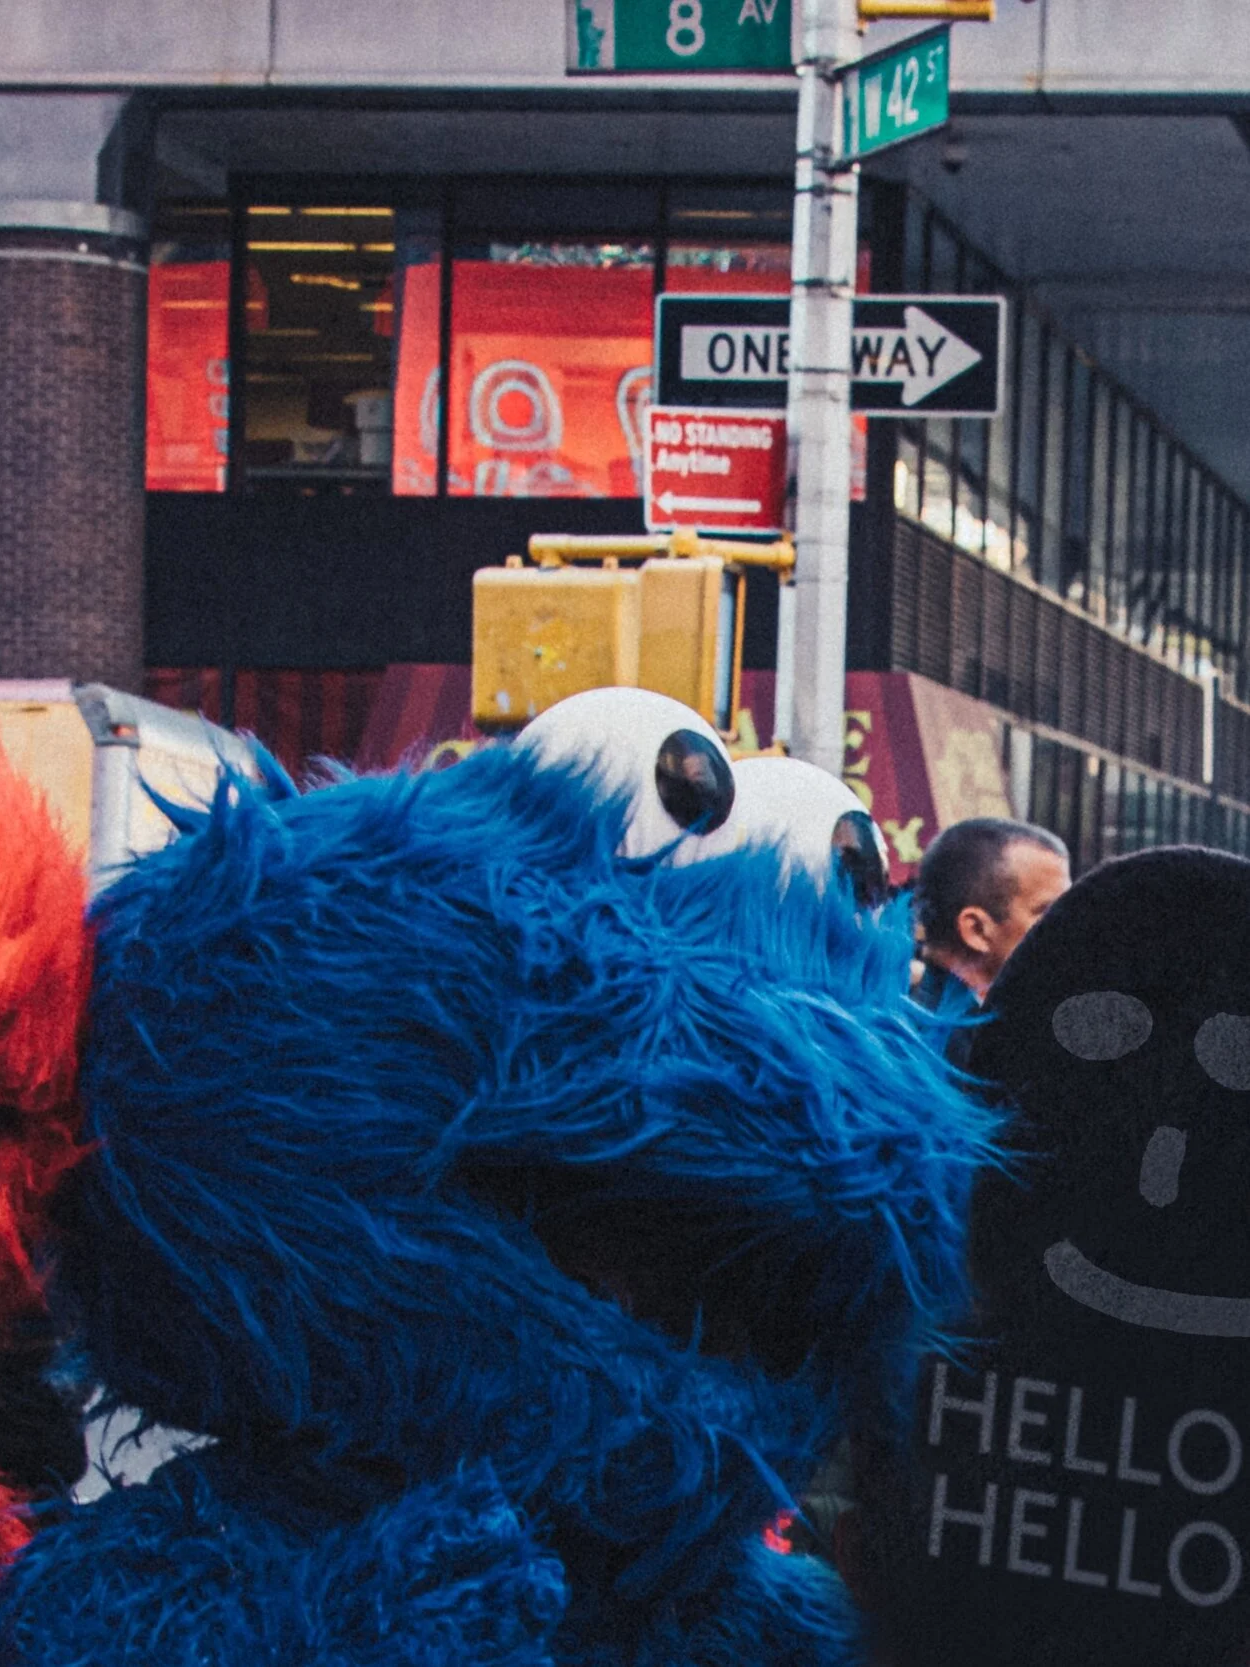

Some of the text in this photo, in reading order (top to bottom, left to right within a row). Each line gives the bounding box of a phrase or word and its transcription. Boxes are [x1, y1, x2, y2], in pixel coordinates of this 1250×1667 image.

[665, 0, 705, 56] 8
[864, 73, 882, 138] W
[886, 56, 919, 128] 42
[852, 335, 947, 377] WAY
[654, 420, 773, 450] NO STANDING
[656, 448, 731, 478] Anytime
[927, 1362, 1242, 1496] HELLO
[927, 1473, 1242, 1607] HELLO
